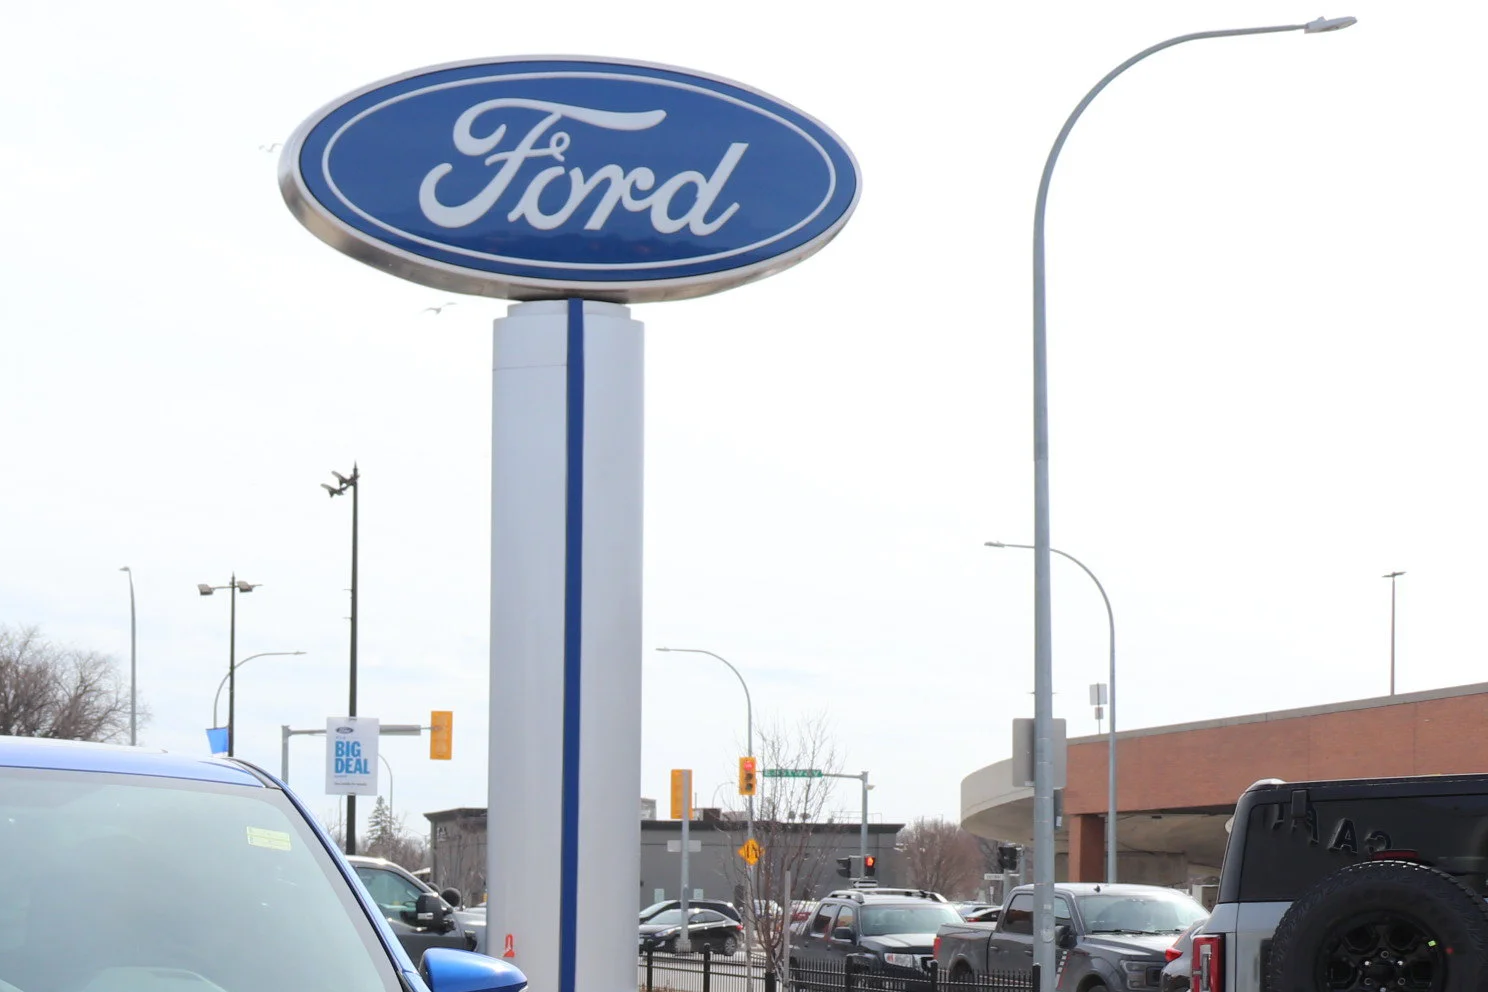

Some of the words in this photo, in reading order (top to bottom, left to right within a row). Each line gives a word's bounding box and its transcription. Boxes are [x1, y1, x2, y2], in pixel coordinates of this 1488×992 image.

[418, 98, 750, 236] Ford
[335, 741, 361, 757] BIG
[335, 758, 371, 774] DEAL
